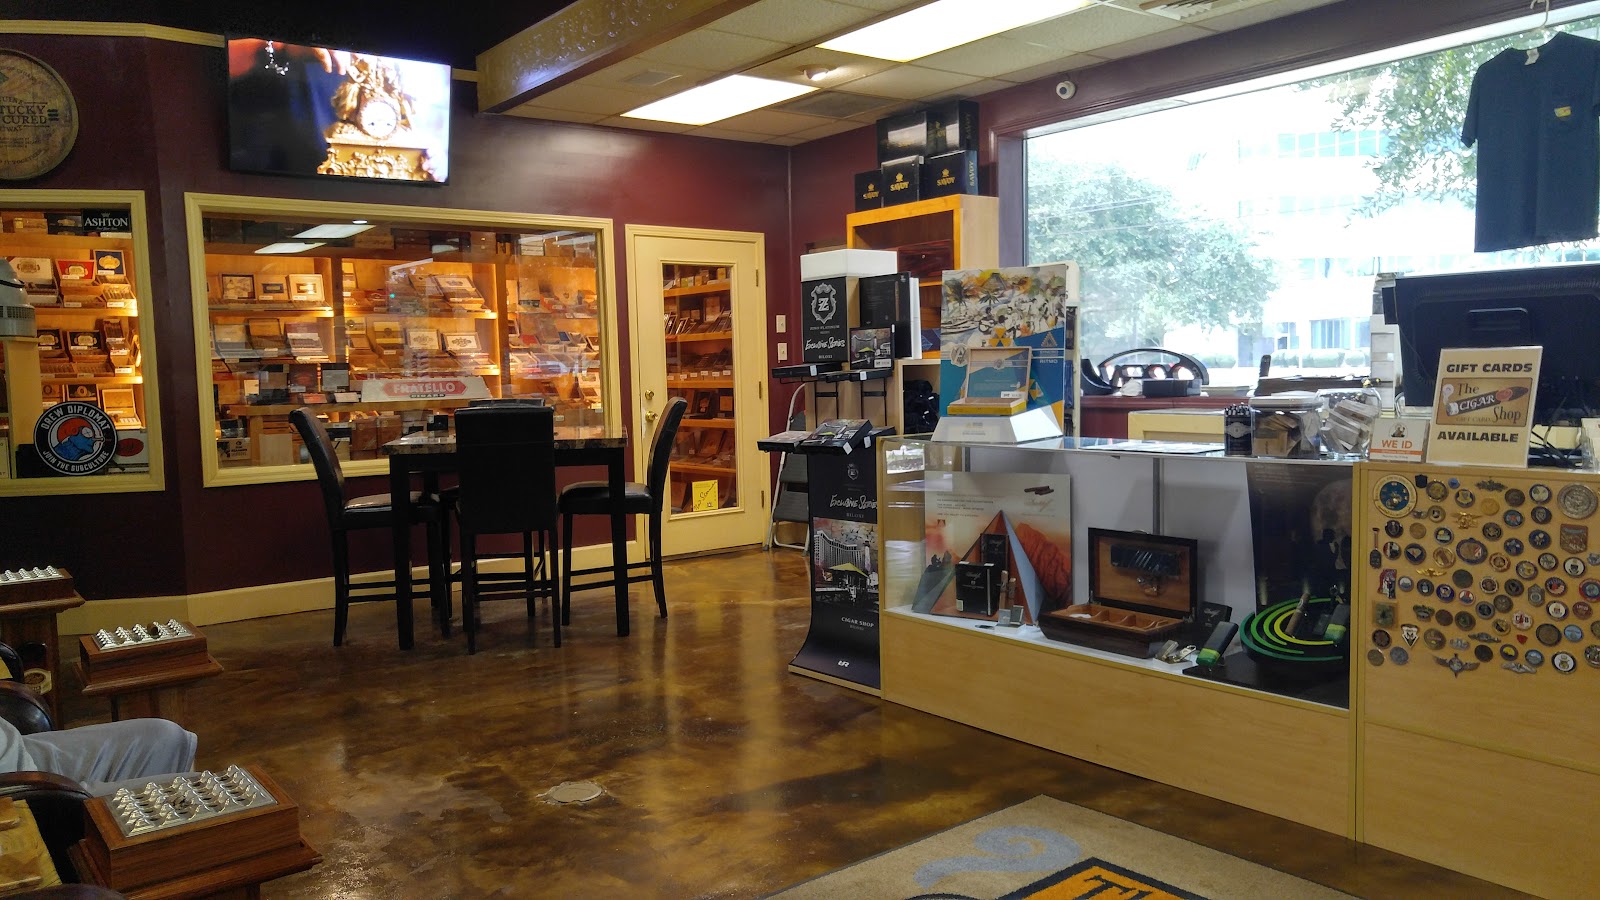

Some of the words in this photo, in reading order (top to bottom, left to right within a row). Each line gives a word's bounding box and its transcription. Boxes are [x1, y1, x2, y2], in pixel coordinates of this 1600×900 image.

[2, 115, 47, 125] CURED
[890, 181, 909, 191] SAVOY
[937, 177, 955, 186] SAVOY
[84, 217, 128, 227] ASHTON
[1446, 363, 1478, 373] GIFT
[1482, 363, 1533, 373] CARDS
[393, 382, 456, 394] FRATELLO
[1458, 383, 1480, 396] The
[1460, 394, 1495, 411] CIGAR
[41, 408, 64, 430] DREW
[67, 405, 111, 430] DIPLOMAT
[1493, 406, 1521, 424] Shop
[1437, 431, 1519, 443] AVAILABLE
[1381, 440, 1398, 449] WE
[1401, 440, 1413, 449] ID
[42, 450, 58, 465] JOIN
[56, 461, 70, 471] THE
[71, 450, 110, 472] SUBCULTURE
[841, 616, 858, 625] CIGAR
[859, 620, 875, 628] SHOP
